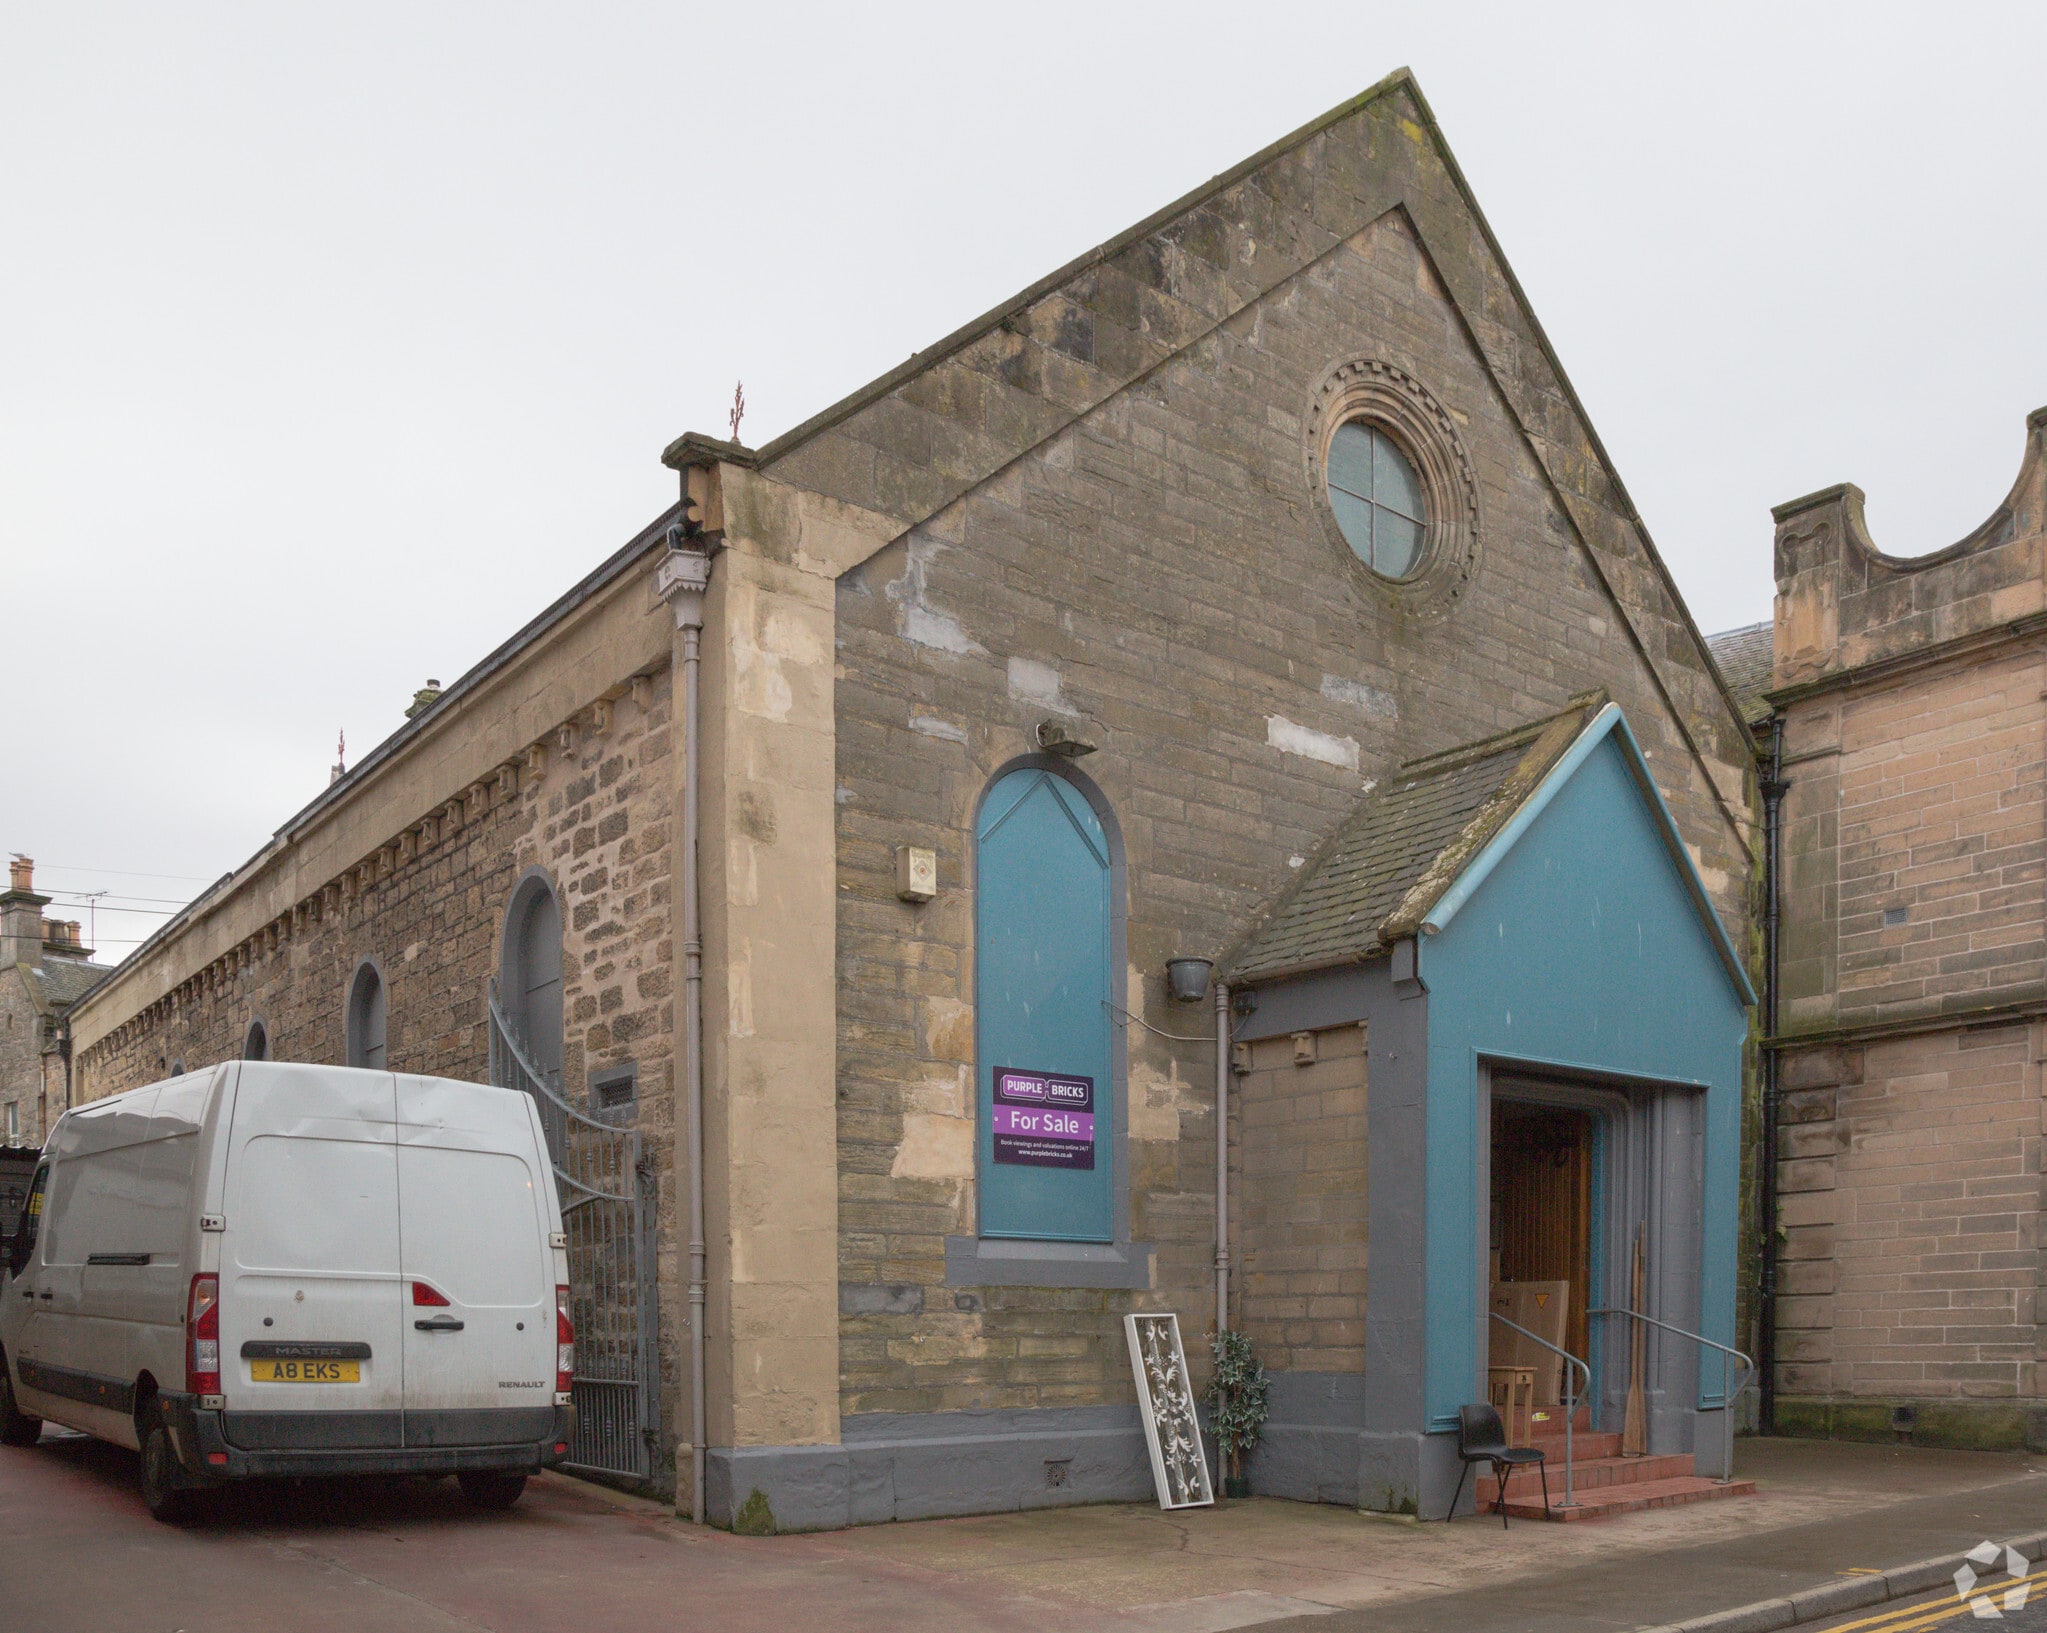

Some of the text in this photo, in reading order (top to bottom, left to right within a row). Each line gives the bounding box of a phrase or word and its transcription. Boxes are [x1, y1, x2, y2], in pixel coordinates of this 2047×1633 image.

[1007, 1080, 1084, 1098] PURPLE BRICKS
[1010, 1110, 1079, 1134] For Sale
[1013, 1141, 1033, 1149] viewings
[1018, 1149, 1073, 1158] www.purplebricks.co.uk
[275, 1347, 342, 1355] MASTER
[273, 1362, 340, 1379] A8 EKS
[498, 1381, 545, 1389] RENAULT
